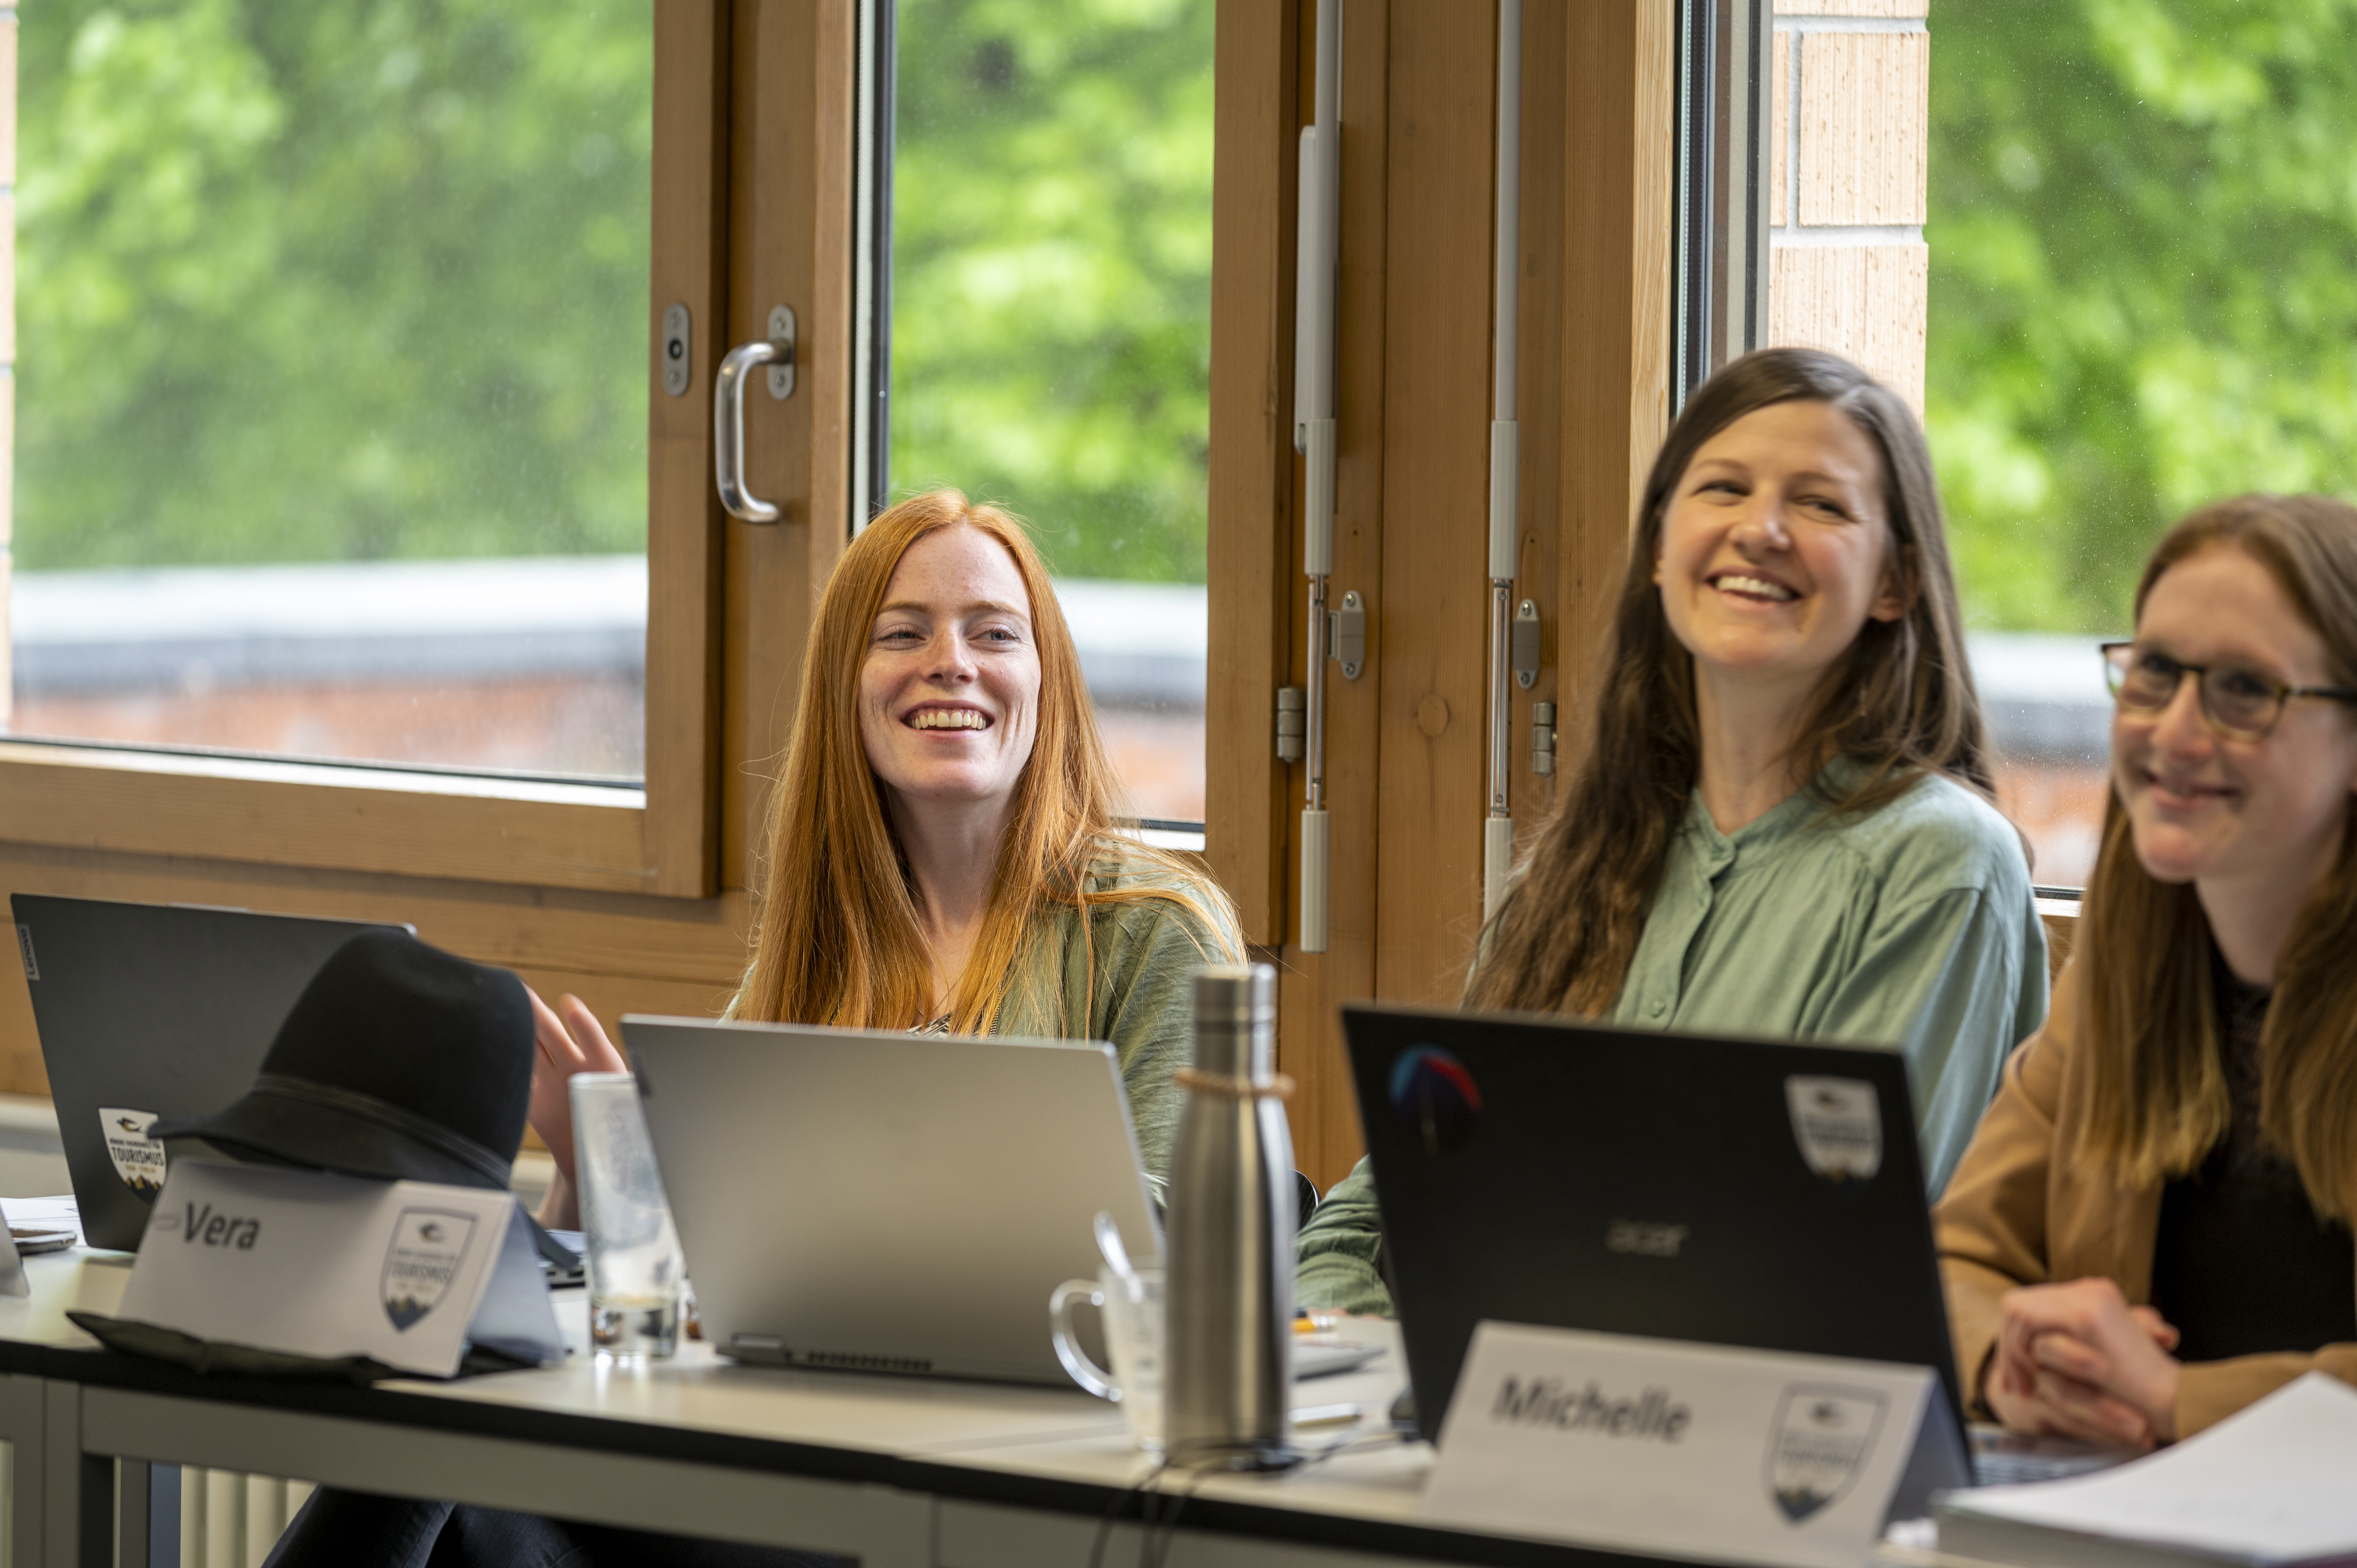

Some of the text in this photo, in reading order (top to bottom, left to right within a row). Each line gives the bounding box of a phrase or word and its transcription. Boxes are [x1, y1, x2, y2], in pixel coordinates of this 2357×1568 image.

[111, 1147, 164, 1166] TOURISMUS
[184, 1200, 260, 1250] Vera
[1604, 1220, 1690, 1257] acer
[1491, 1373, 1692, 1444] Michelle
